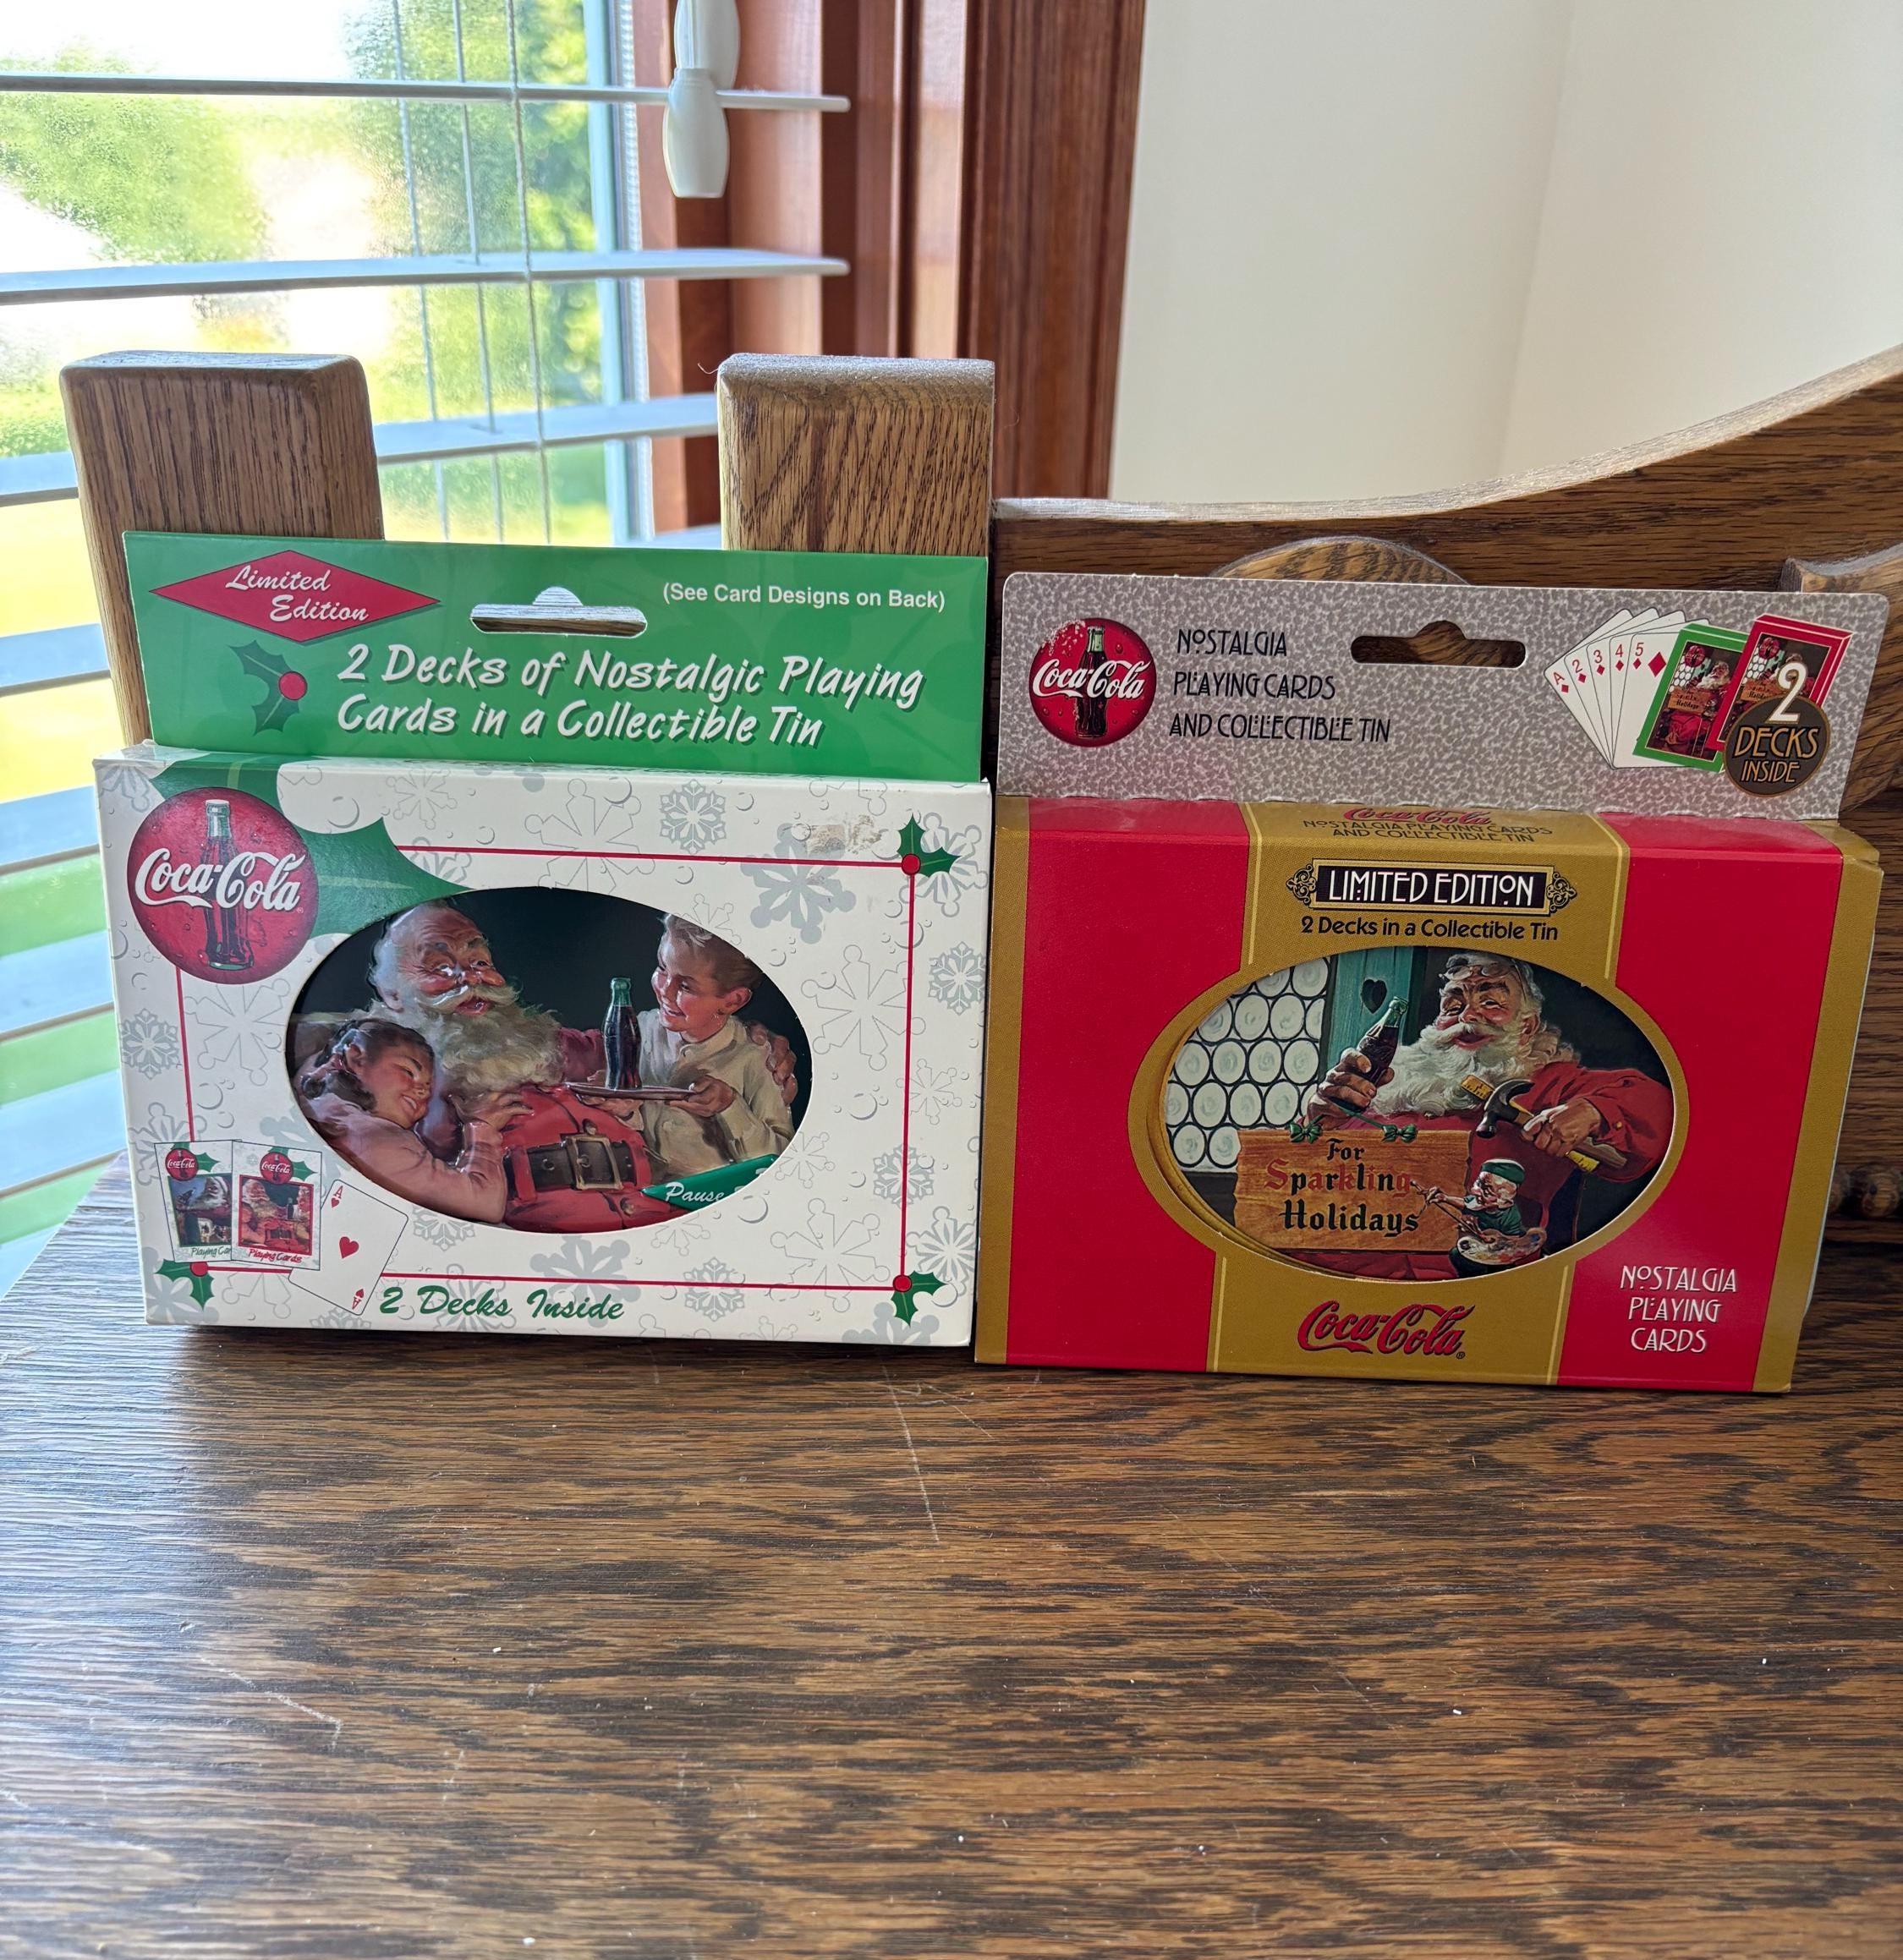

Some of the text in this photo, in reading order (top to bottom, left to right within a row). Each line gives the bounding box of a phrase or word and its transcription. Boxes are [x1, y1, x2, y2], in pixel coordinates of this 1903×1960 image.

[225, 565, 332, 591] Limited
[269, 594, 370, 622] Edition
[663, 583, 946, 613] (See Card Designs on Back)
[1177, 628, 1287, 657] NOSTALGIA
[1615, 643, 1624, 658] 4
[1635, 642, 1644, 657] 5
[1571, 659, 1582, 673] 2
[1593, 649, 1603, 664] 3
[338, 644, 924, 709] 2 Decks of Nostalgic Playing
[1032, 659, 1151, 699] Coca-Cola
[1173, 671, 1335, 700] PLAYING CARDS
[1553, 671, 1565, 685] A
[1769, 662, 1807, 723] 2
[338, 693, 824, 747] Cards in a Collectible Tin
[1169, 713, 1390, 743] AND COLLECTIBLE TIN
[1734, 726, 1819, 758] DECKS
[1740, 761, 1801, 783] INSIDE
[1342, 808, 1494, 824] Coca-Cola
[1407, 823, 1483, 833] PLAYING
[1485, 824, 1553, 835] CARDS
[1332, 828, 1535, 842] AND COLLECTIBLE TIN
[134, 847, 305, 911] Coca-Cola
[1329, 870, 1534, 906] LIMITED EDITION
[1301, 917, 1558, 940] 2 Decks in a Collectible Tin
[1326, 1137, 1365, 1161] For
[1264, 1158, 1412, 1198] Sparkling
[335, 1185, 343, 1200] A
[666, 1182, 725, 1202] Pause
[1279, 1199, 1421, 1238] Holidays
[191, 1247, 217, 1259] Playing
[249, 1248, 303, 1263] Playing Cards
[1620, 1265, 1737, 1294] NOSTALGIA
[352, 1296, 361, 1309] A
[380, 1285, 624, 1320] 2 Decks Inside
[1627, 1295, 1722, 1323] PLAYING
[1297, 1300, 1476, 1355] Coca-Cola
[1631, 1328, 1707, 1352] CARDS
